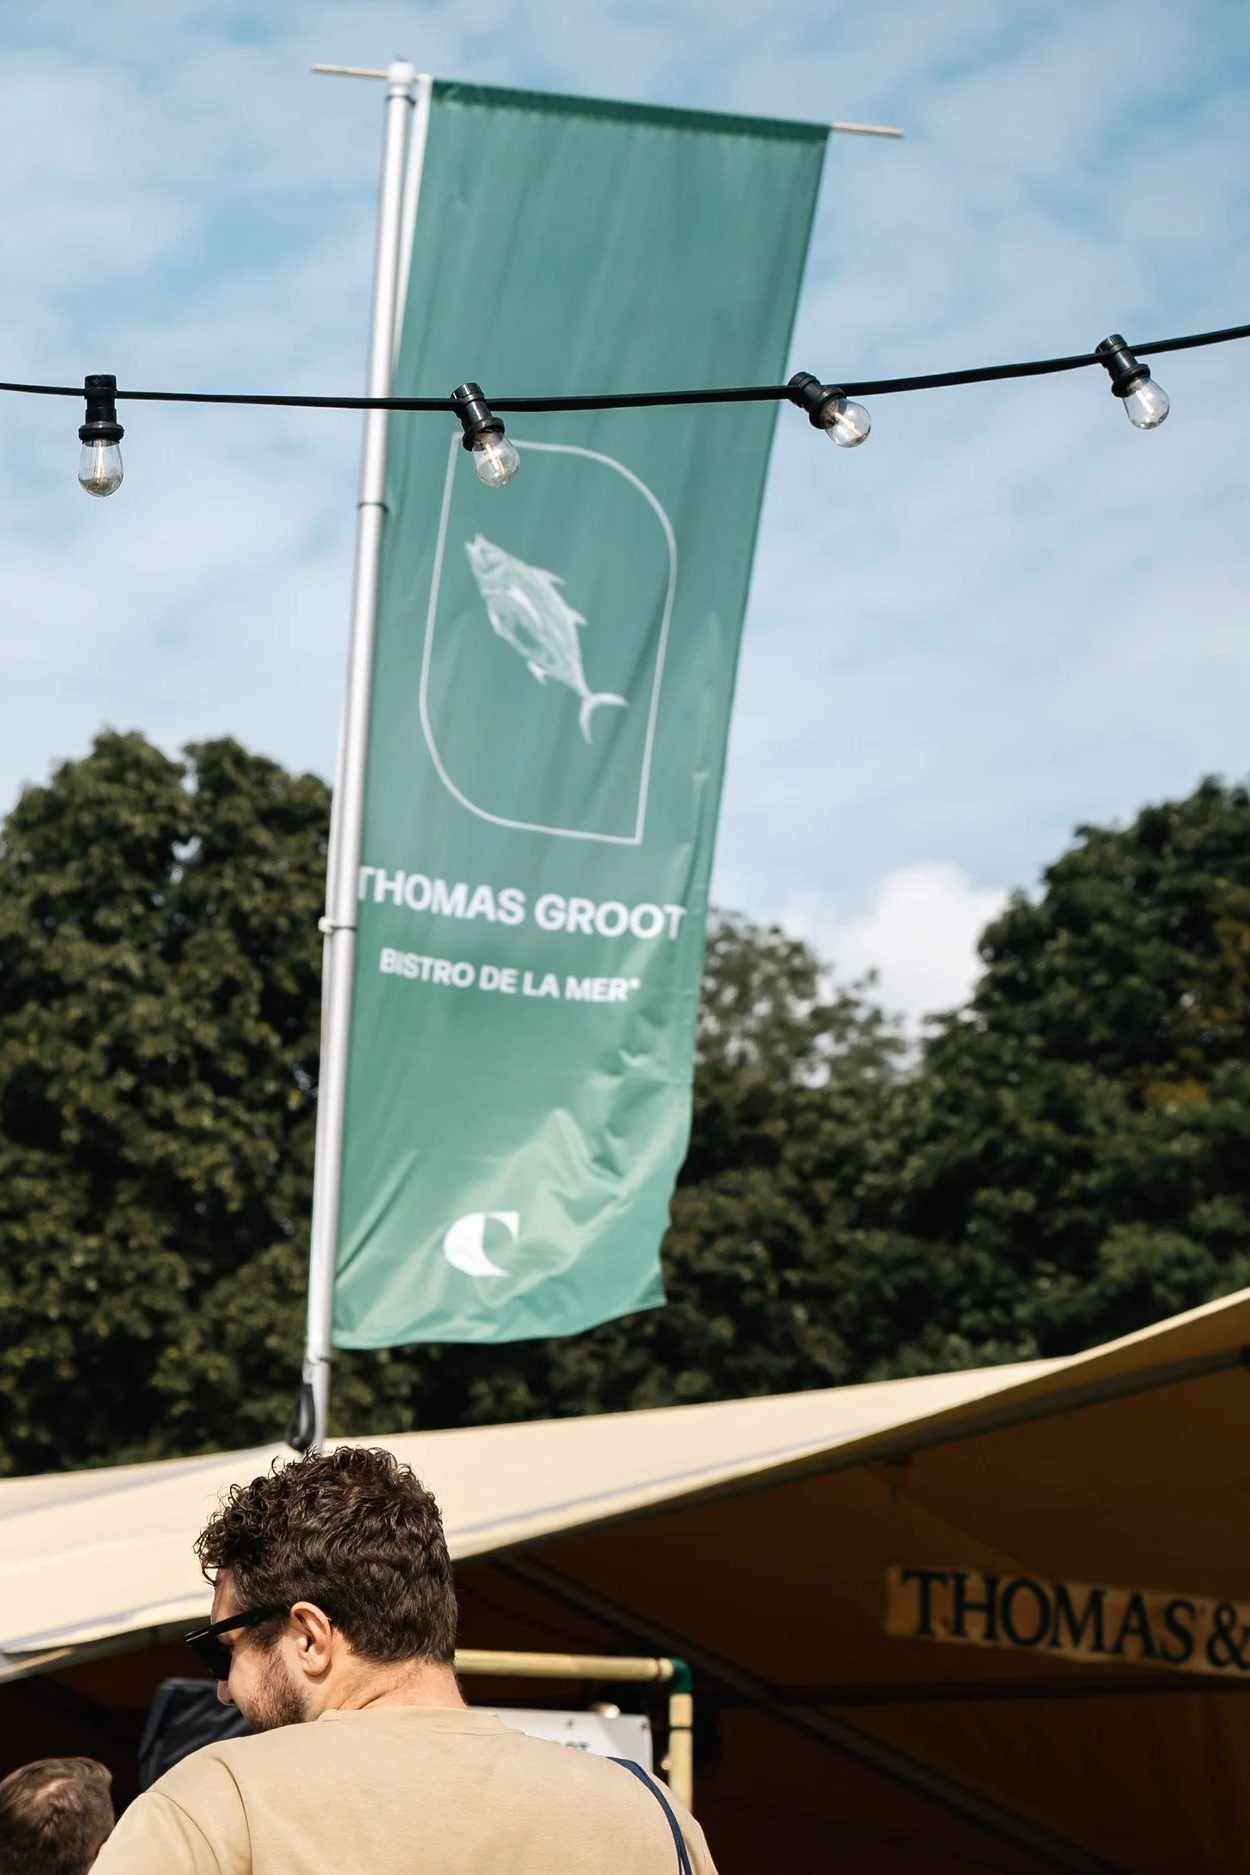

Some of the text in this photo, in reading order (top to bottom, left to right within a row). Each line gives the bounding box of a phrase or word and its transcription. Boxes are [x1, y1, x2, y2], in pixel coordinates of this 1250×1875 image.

[357, 866, 686, 941] THOMAS GROOT
[379, 947, 475, 987] BISTRO
[479, 966, 518, 993] DE
[523, 971, 561, 998] LA
[900, 1569, 1197, 1665] THOMAS
